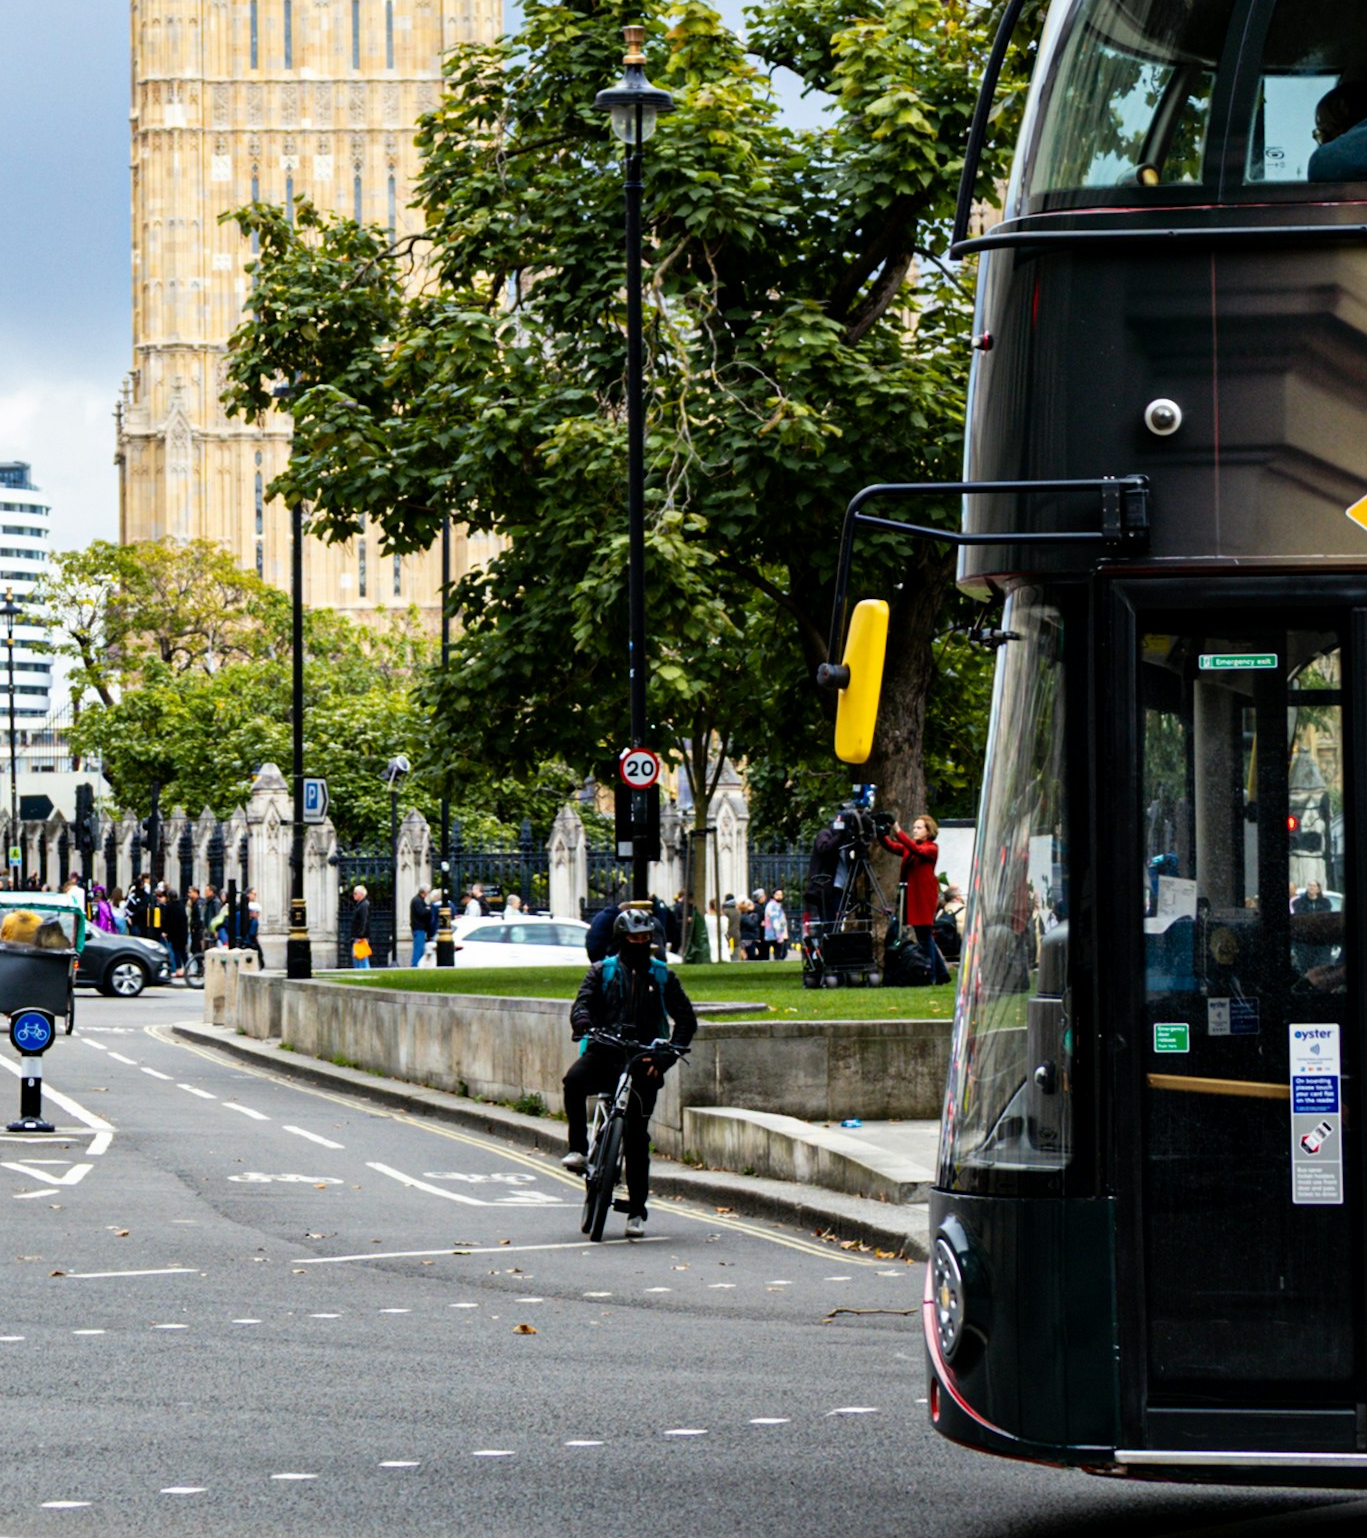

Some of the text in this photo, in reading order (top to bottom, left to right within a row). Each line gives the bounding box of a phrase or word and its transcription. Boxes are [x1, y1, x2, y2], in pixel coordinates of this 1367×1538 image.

[1216, 658, 1254, 666] Emergency
[627, 760, 654, 777] 20
[1294, 1029, 1332, 1041] oyster
